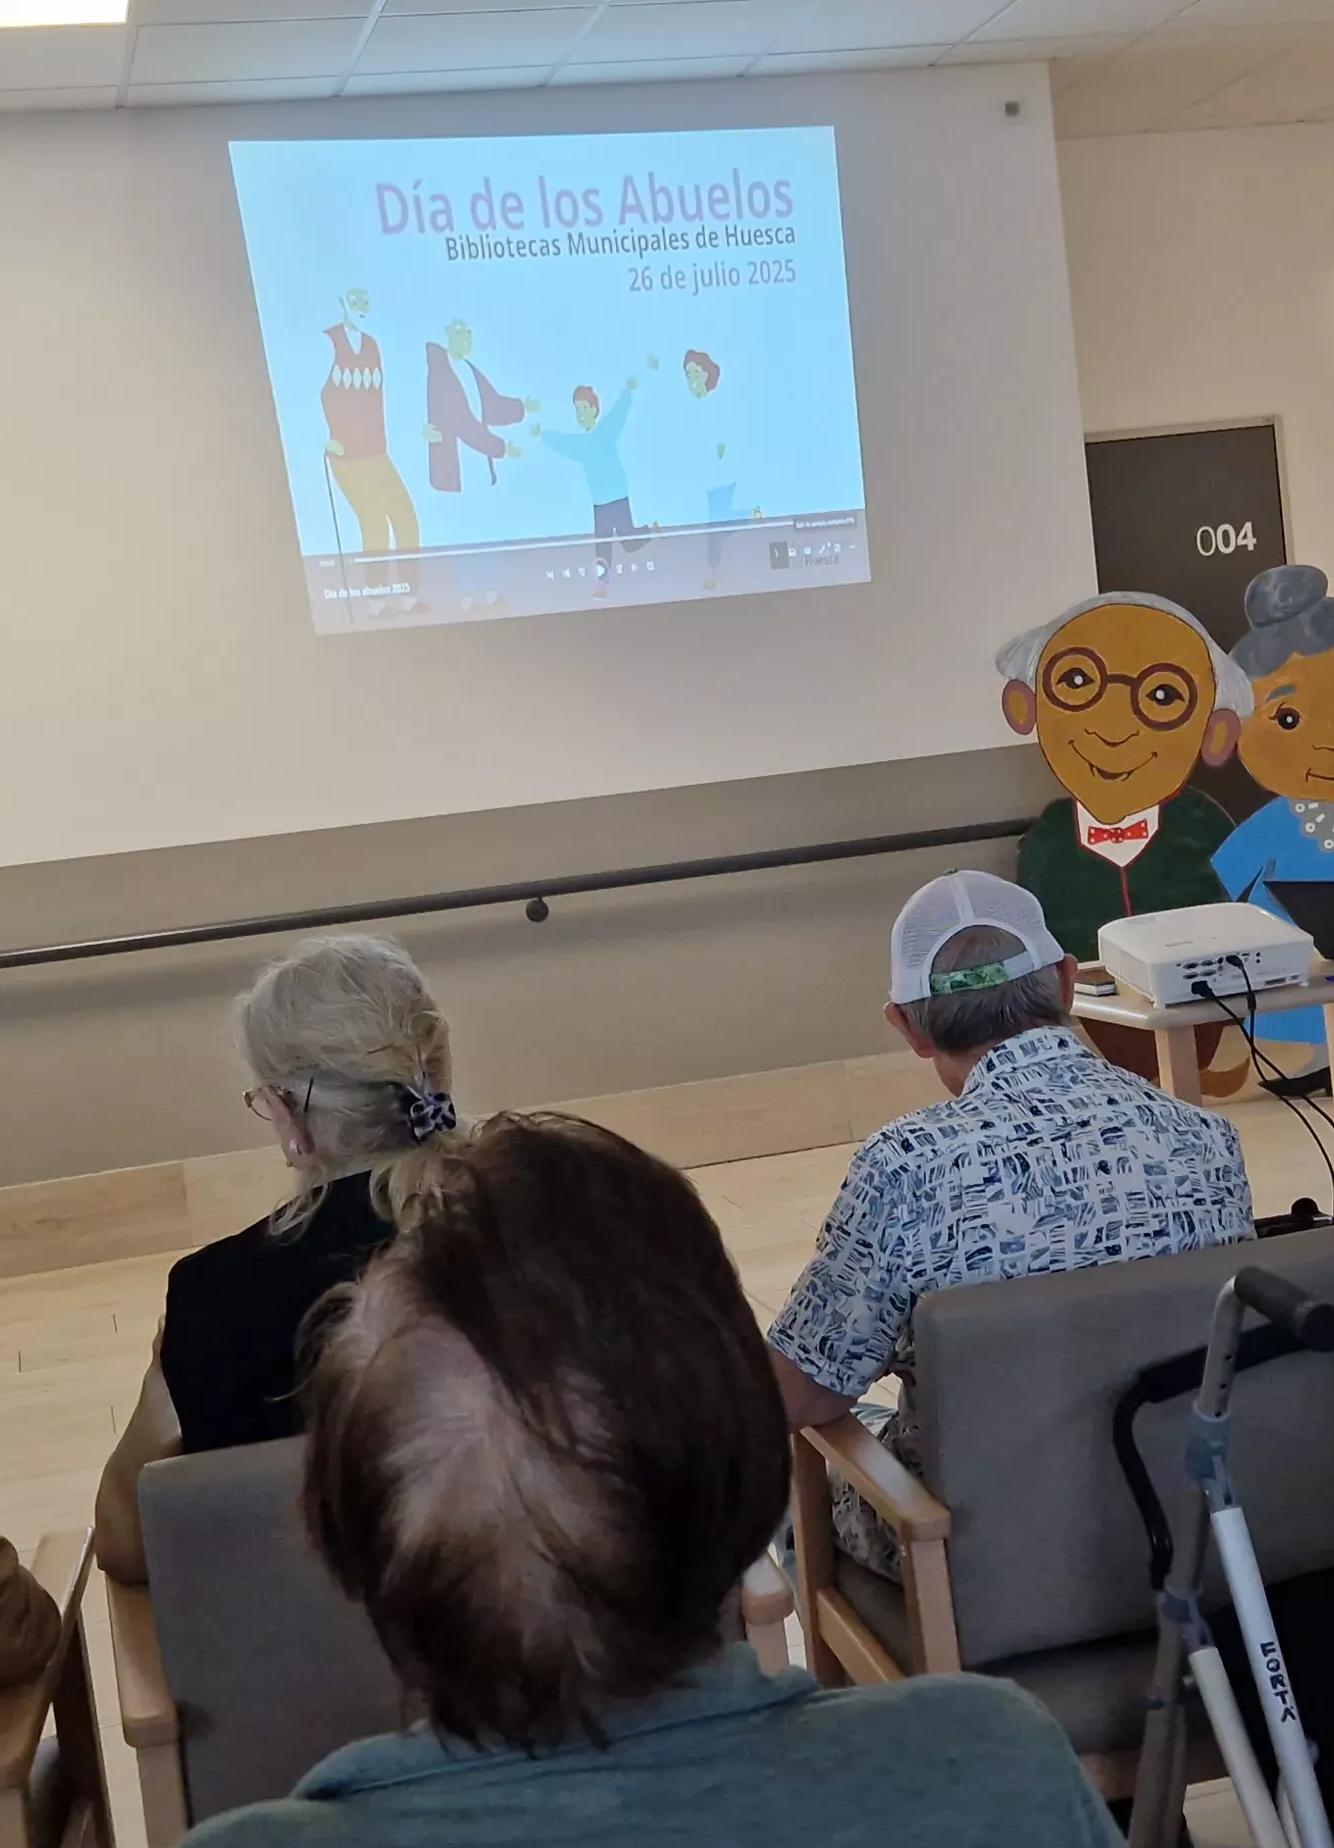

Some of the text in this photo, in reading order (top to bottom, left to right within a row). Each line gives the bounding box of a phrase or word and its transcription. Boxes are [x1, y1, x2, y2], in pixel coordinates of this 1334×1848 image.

[375, 168, 794, 235] Día de los Abuelos
[445, 224, 796, 261] Bibliotecas Municipales de Huesca
[628, 258, 796, 296] 26 de julio 2025
[1196, 521, 1258, 556] 004
